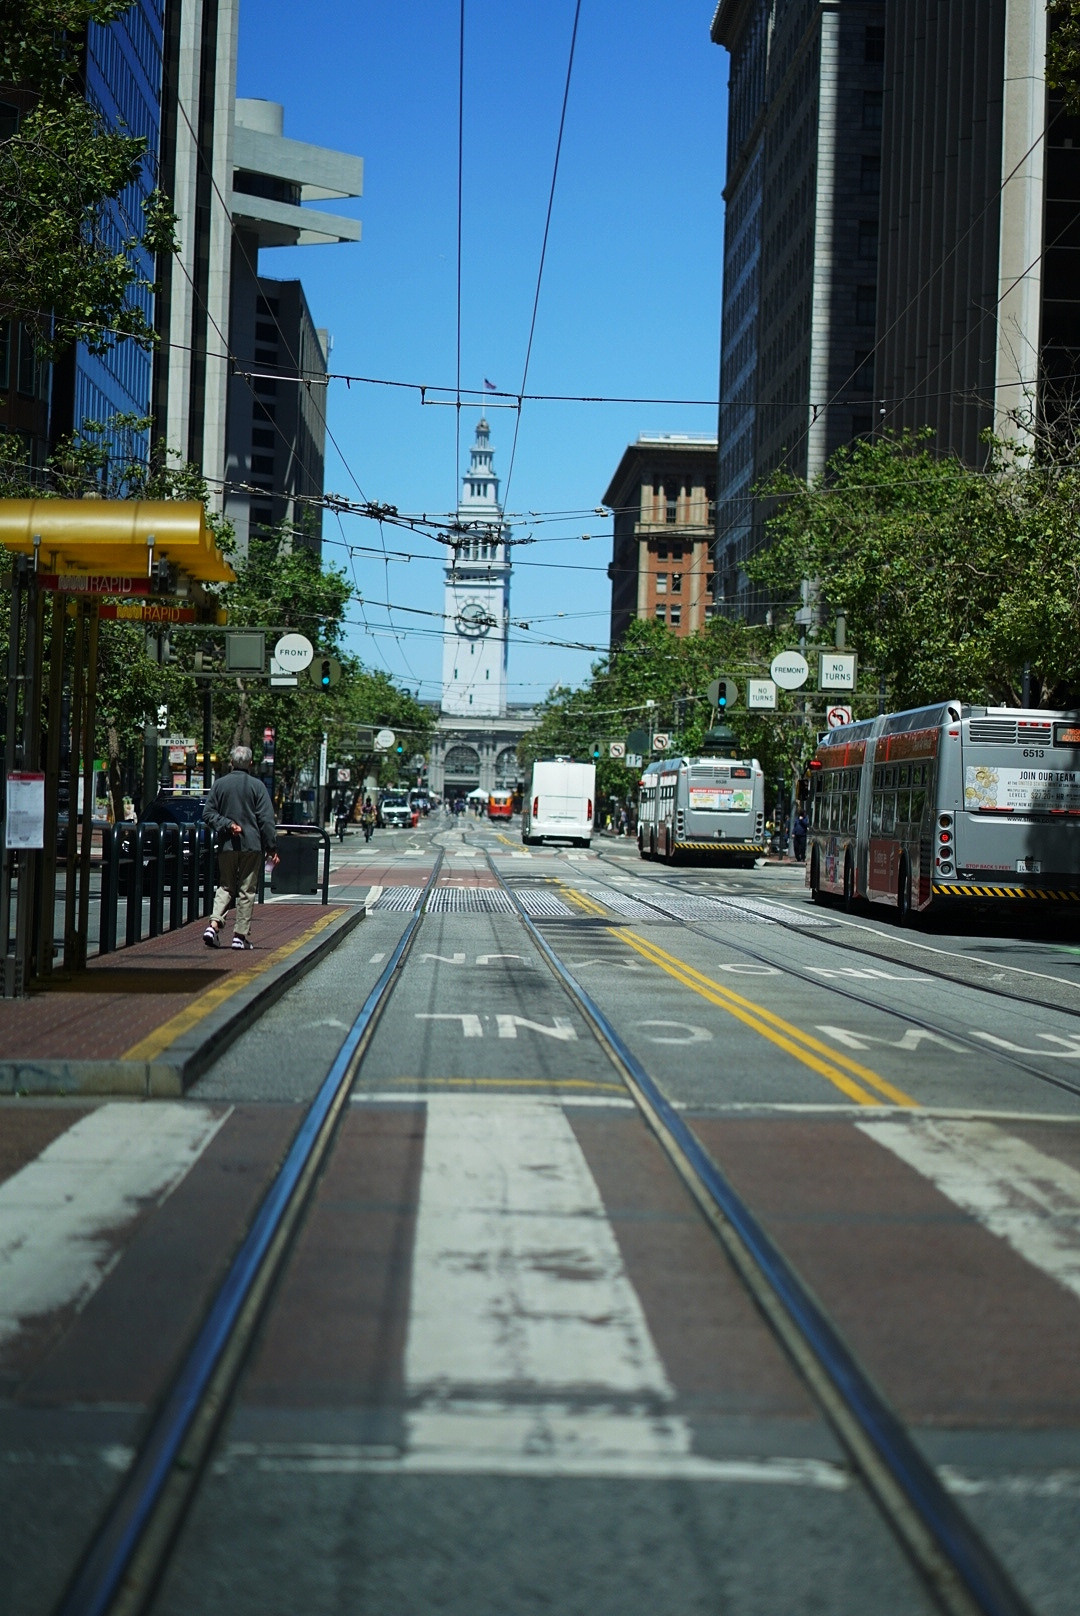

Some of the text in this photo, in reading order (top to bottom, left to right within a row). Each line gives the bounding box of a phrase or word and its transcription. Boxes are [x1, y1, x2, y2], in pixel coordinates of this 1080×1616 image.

[90, 576, 132, 593] RAPID
[143, 606, 180, 622] RAPID
[279, 649, 308, 657] FRONT
[774, 666, 805, 674] FREMONT
[832, 664, 844, 672] NO
[825, 673, 851, 681] TURNS
[757, 687, 768, 695] NO
[1022, 749, 1045, 758] 6513
[1019, 771, 1076, 782] JOIN OUR TEAM
